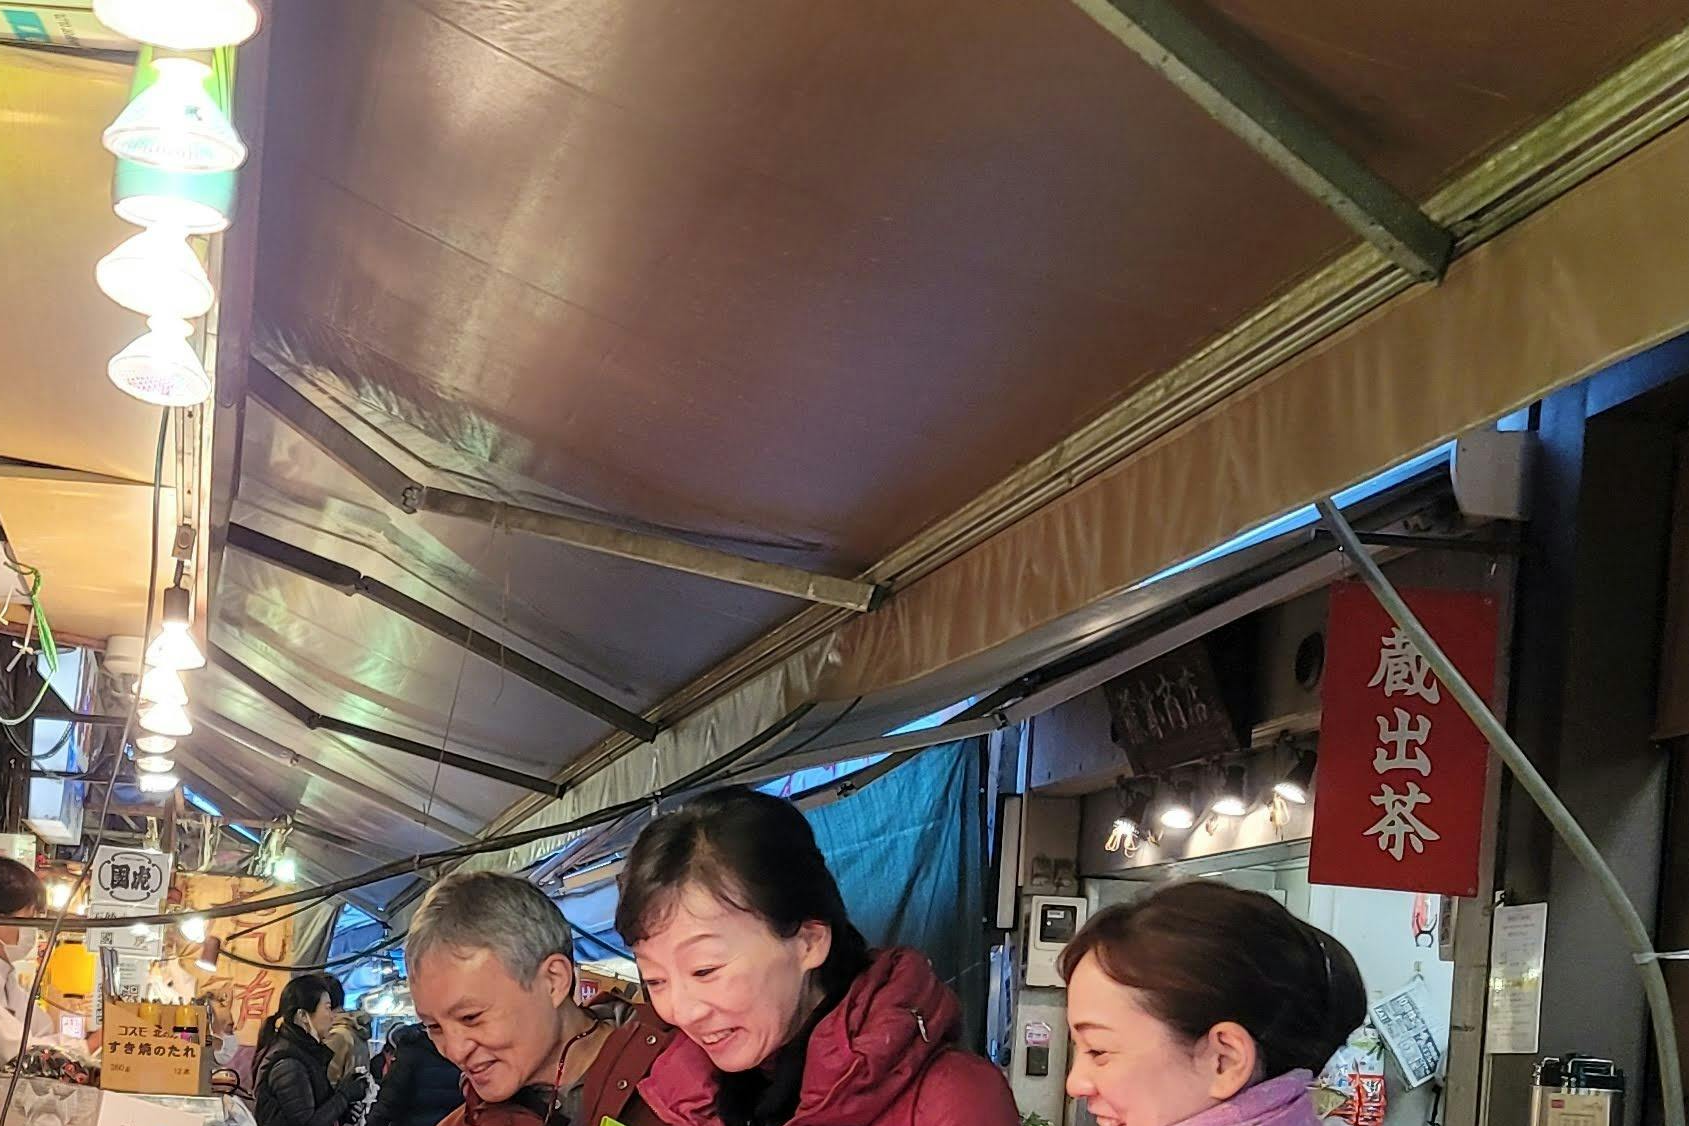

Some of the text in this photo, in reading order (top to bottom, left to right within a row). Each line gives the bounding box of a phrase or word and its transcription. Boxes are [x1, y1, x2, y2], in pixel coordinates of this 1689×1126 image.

[1363, 627, 1441, 861] 蔵出茶
[108, 1040, 197, 1059] すき焼のたれ
